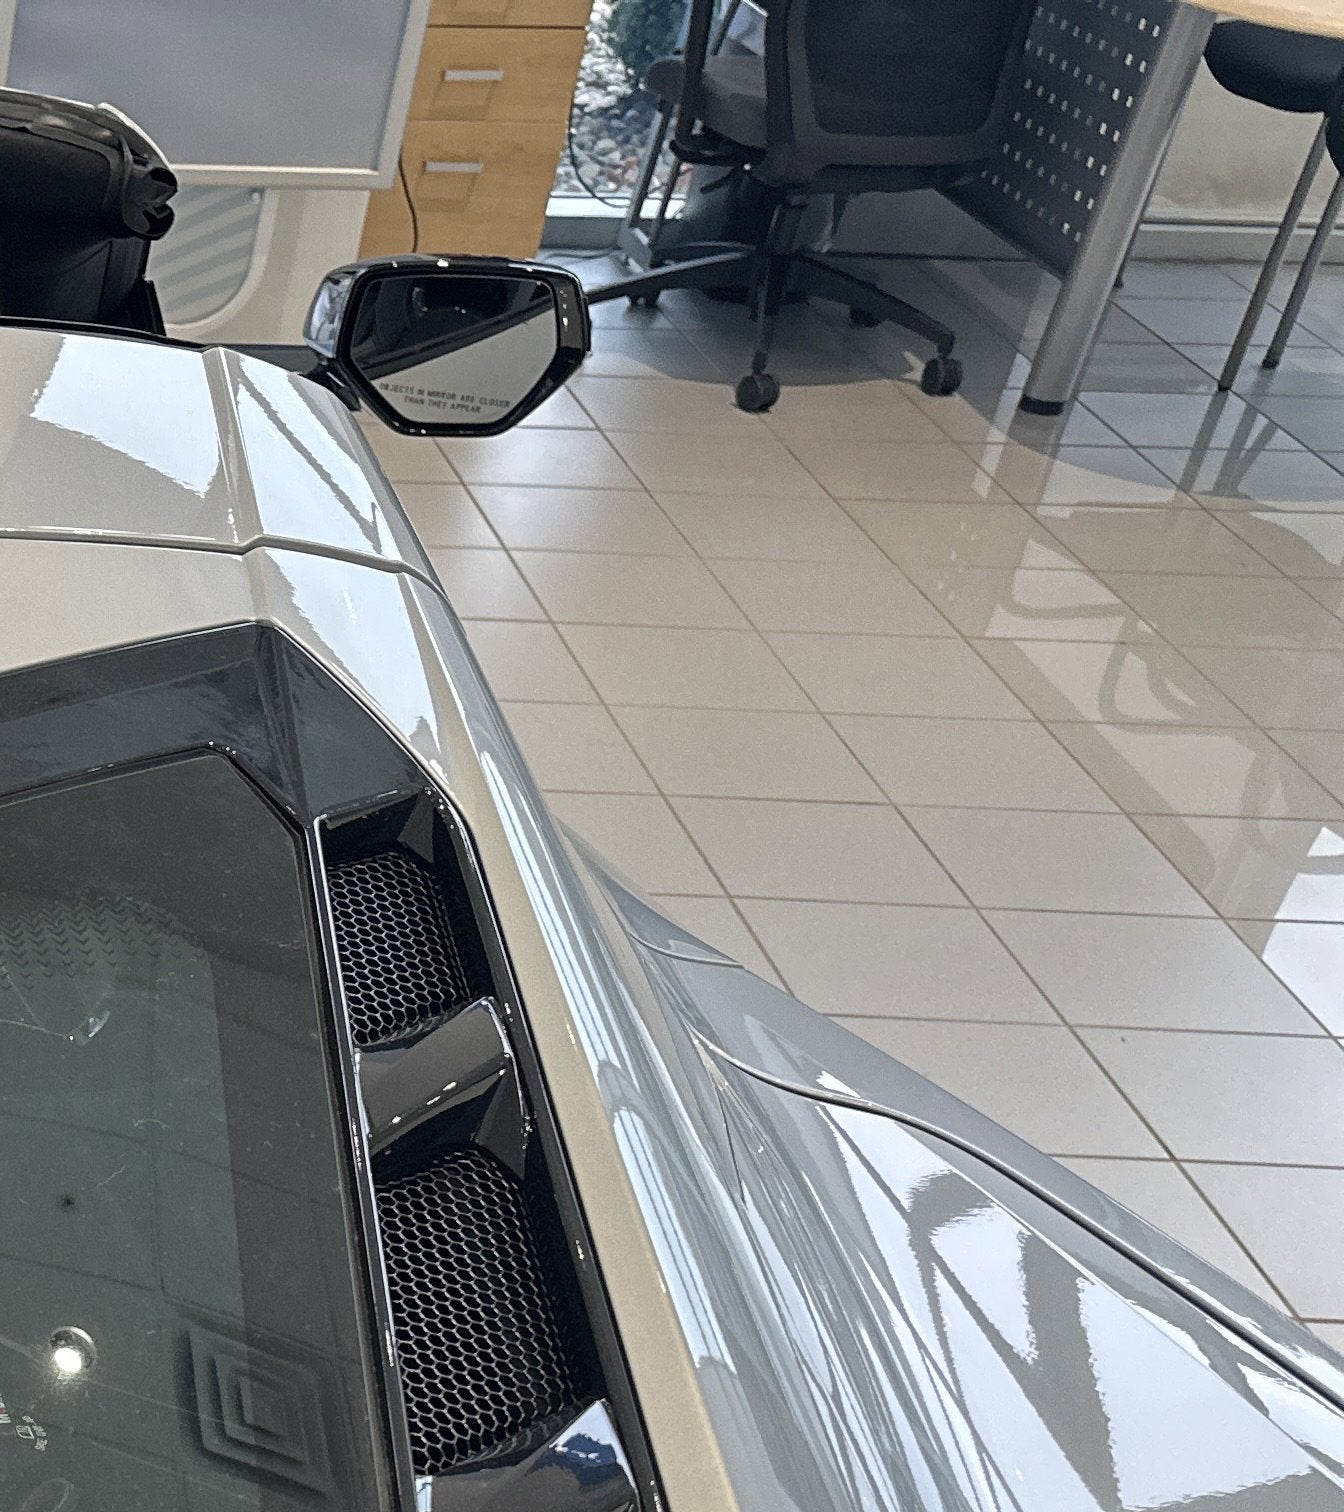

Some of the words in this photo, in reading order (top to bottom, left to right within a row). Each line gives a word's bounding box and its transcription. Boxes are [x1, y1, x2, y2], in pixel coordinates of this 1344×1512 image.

[378, 382, 415, 395] OBJECTS
[427, 389, 458, 401] MIRROR
[460, 394, 476, 403] ARE
[479, 397, 511, 409] CLOSER
[404, 395, 426, 405] THAN
[428, 399, 449, 409] THEY
[450, 402, 483, 413] APPEAR
